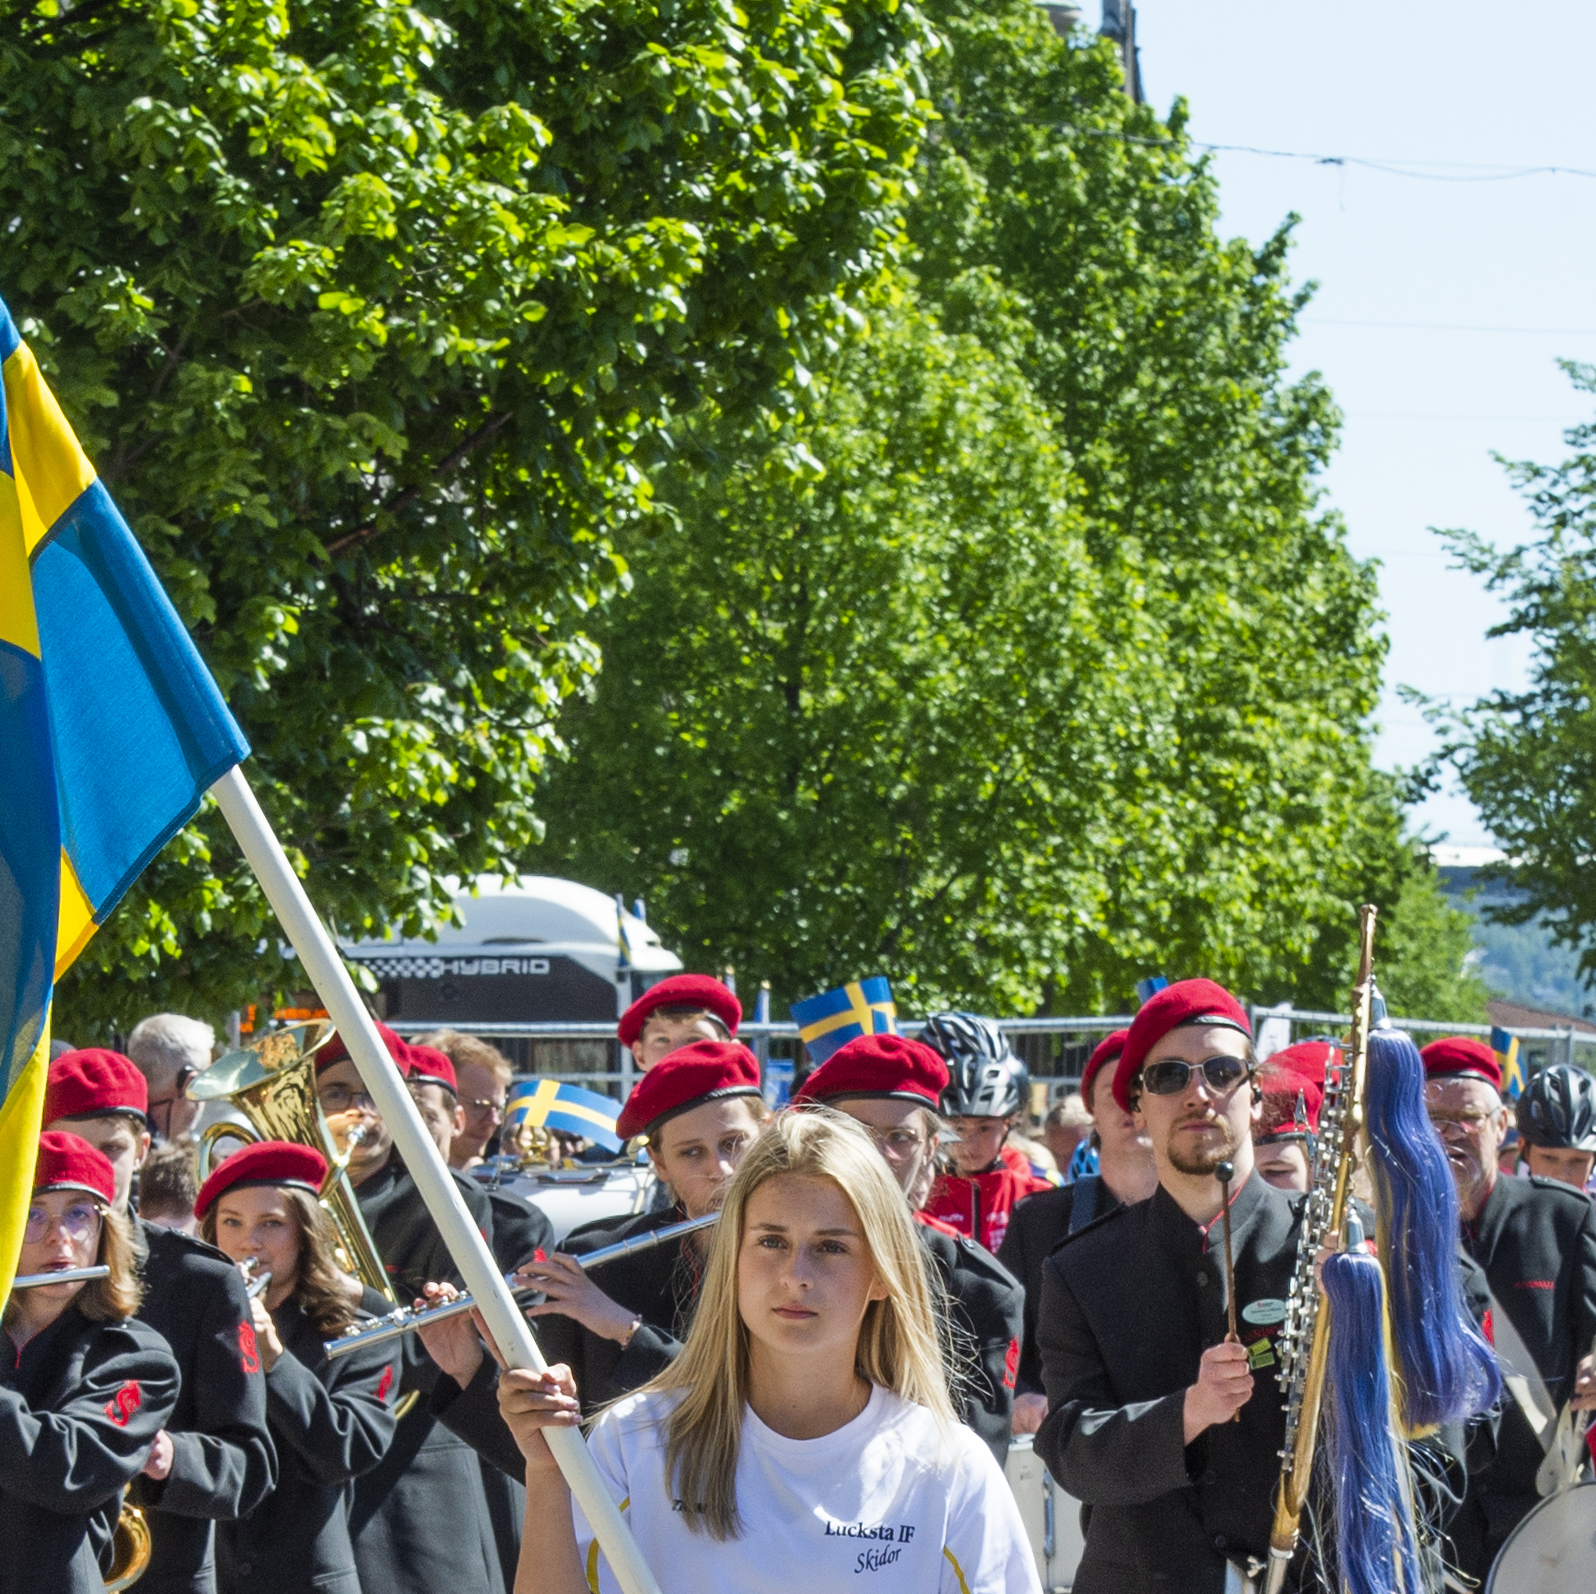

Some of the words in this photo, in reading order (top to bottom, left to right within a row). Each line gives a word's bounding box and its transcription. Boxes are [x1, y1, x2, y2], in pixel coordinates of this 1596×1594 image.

[439, 958, 551, 975] HYBRID
[824, 1521, 894, 1541] Lucksta
[898, 1525, 915, 1543] IF
[854, 1544, 902, 1573] Skidor
